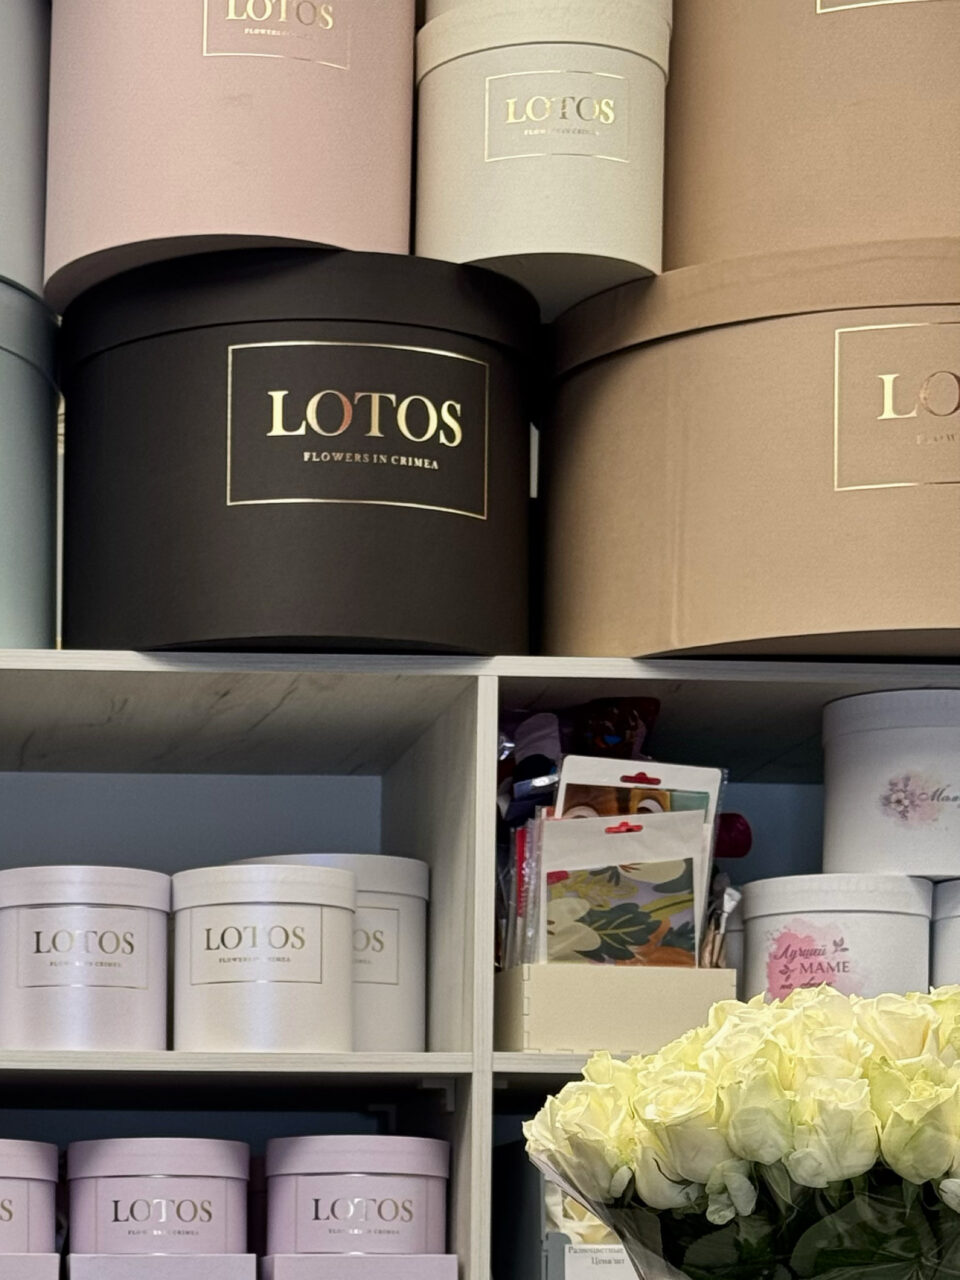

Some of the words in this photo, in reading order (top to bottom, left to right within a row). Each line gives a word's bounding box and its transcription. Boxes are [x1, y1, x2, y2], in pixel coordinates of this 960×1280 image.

[505, 95, 616, 125] LOTOS
[266, 389, 463, 448] LOTOS
[303, 451, 370, 464] FLOWERS
[373, 453, 388, 464] IN
[391, 456, 439, 470] CRIMEA
[33, 929, 135, 955] LOTOS
[204, 925, 306, 951] LOTOS
[111, 1198, 213, 1223] LOTOS
[311, 1197, 414, 1223] LOTOS
